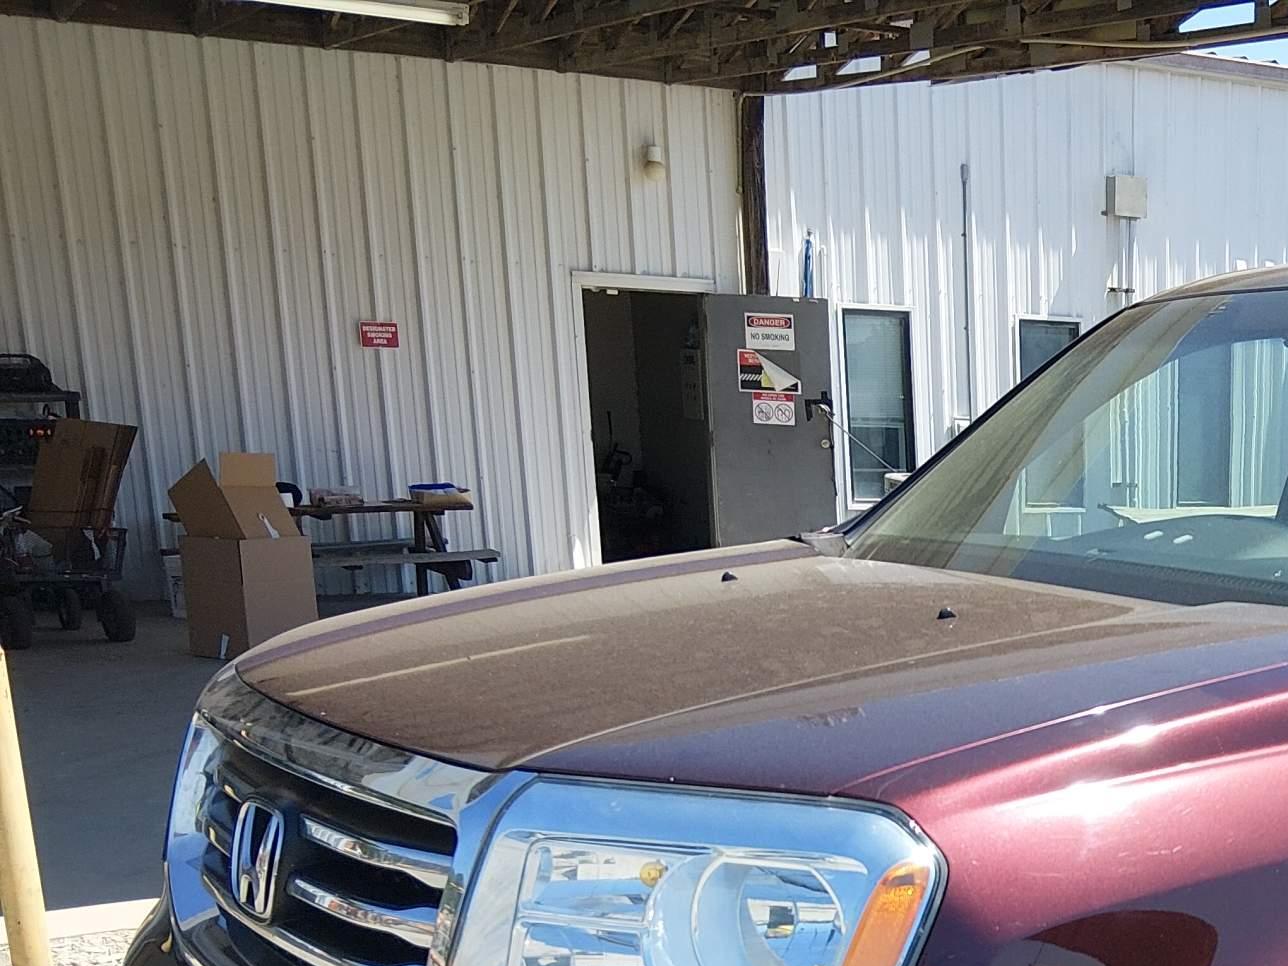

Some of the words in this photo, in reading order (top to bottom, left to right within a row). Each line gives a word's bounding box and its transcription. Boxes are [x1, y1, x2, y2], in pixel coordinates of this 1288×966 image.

[753, 319, 787, 328] DANGER
[751, 333, 760, 341] NO
[761, 333, 790, 342] SMOKING
